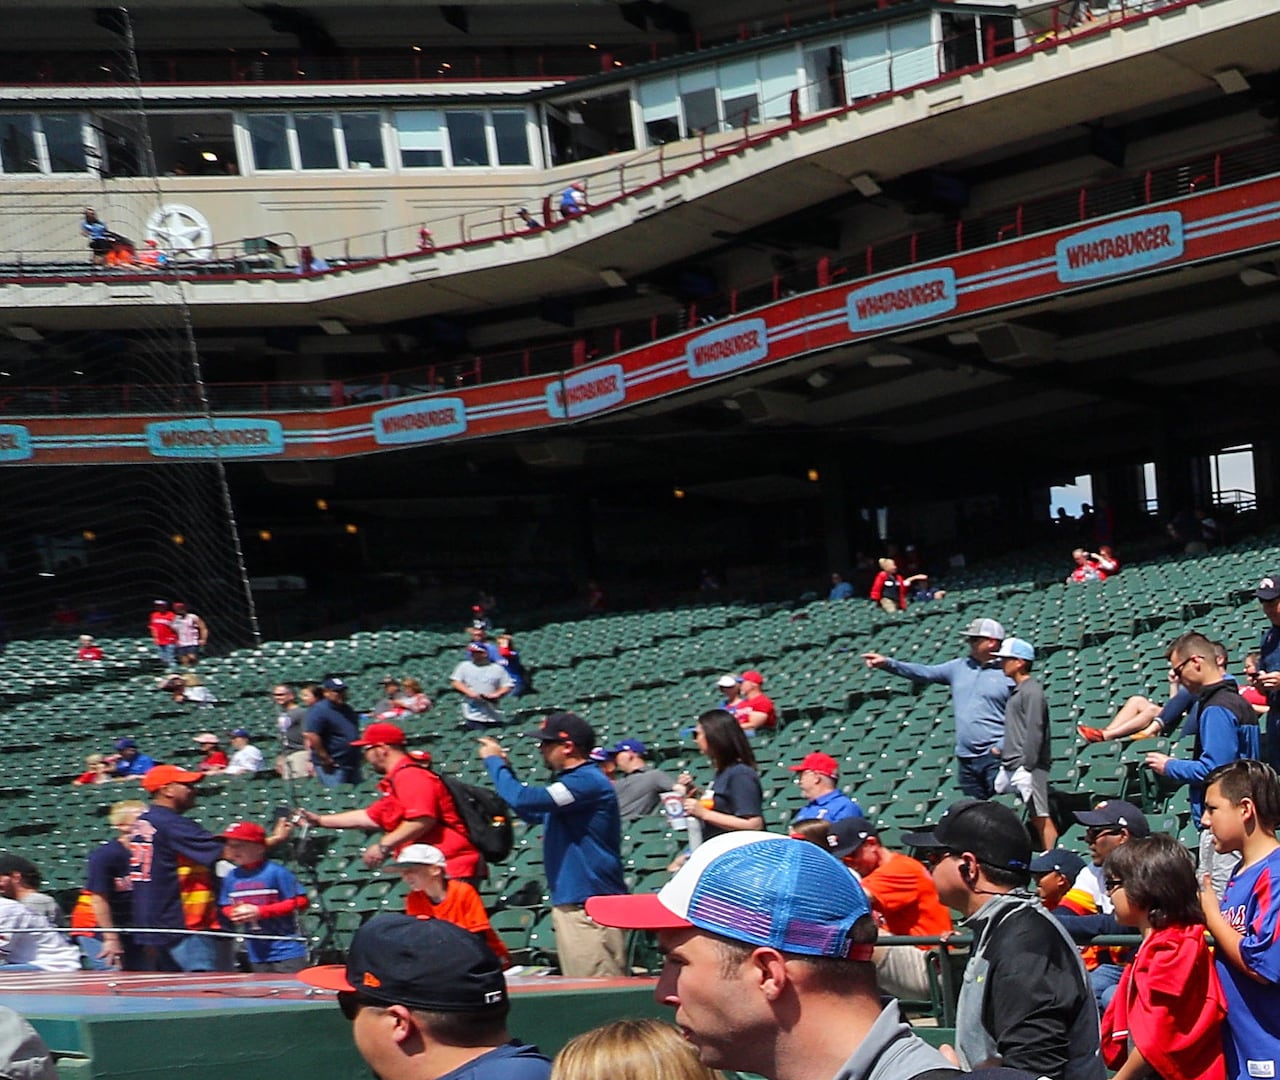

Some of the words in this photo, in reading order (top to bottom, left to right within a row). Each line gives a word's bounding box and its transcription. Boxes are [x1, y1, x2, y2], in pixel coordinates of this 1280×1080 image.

[1066, 225, 1173, 269] WHATABURGER
[855, 279, 950, 320] WHATABURGER
[693, 328, 761, 367] WHATABURGER
[555, 375, 619, 408] WHATABURGER
[381, 407, 459, 434] WHATABURGER
